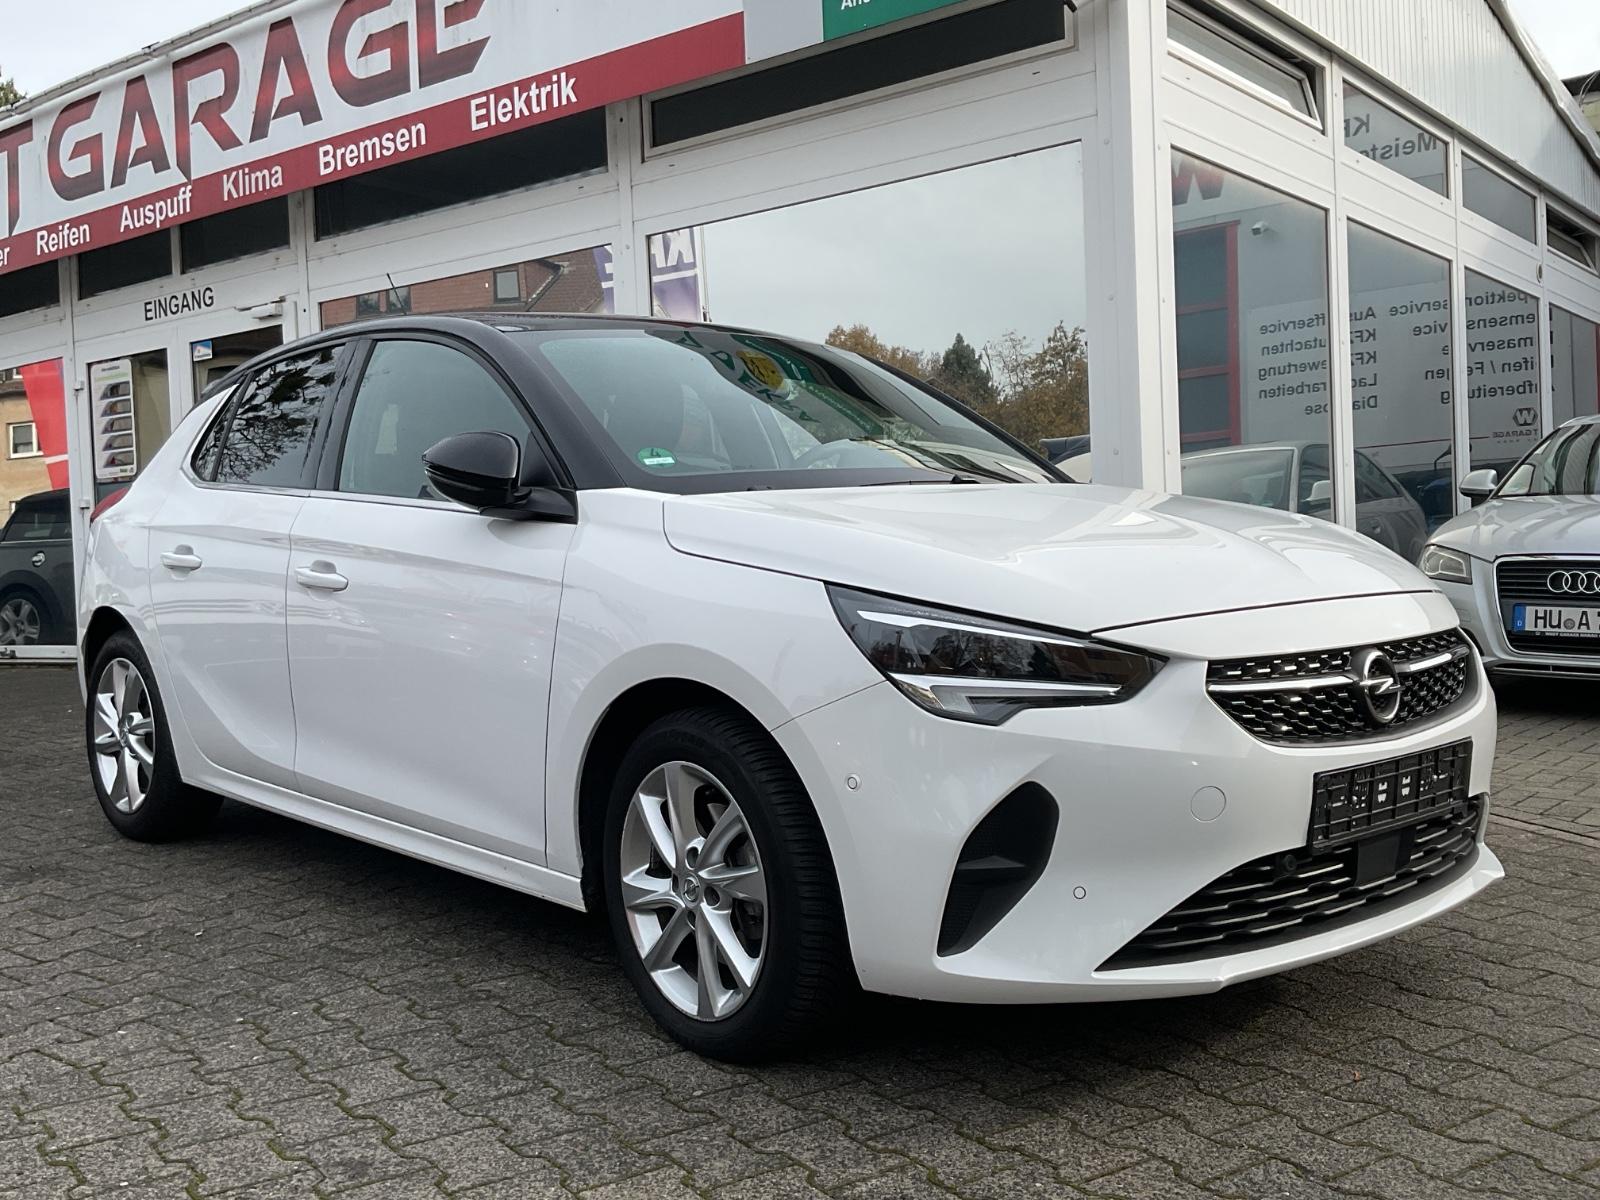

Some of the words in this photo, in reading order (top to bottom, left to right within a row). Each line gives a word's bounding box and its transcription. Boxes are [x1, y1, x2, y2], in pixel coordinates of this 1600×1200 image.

[47, 0, 491, 201] GARAGE
[36, 222, 90, 256] Reifen
[120, 185, 192, 232] Auspuff
[222, 163, 283, 201] Klima
[318, 122, 427, 176] Bremsen
[470, 72, 578, 132] Elektrik
[143, 287, 214, 321] EINGANG
[1534, 609, 1562, 629] HU
[1578, 611, 1590, 631] A
